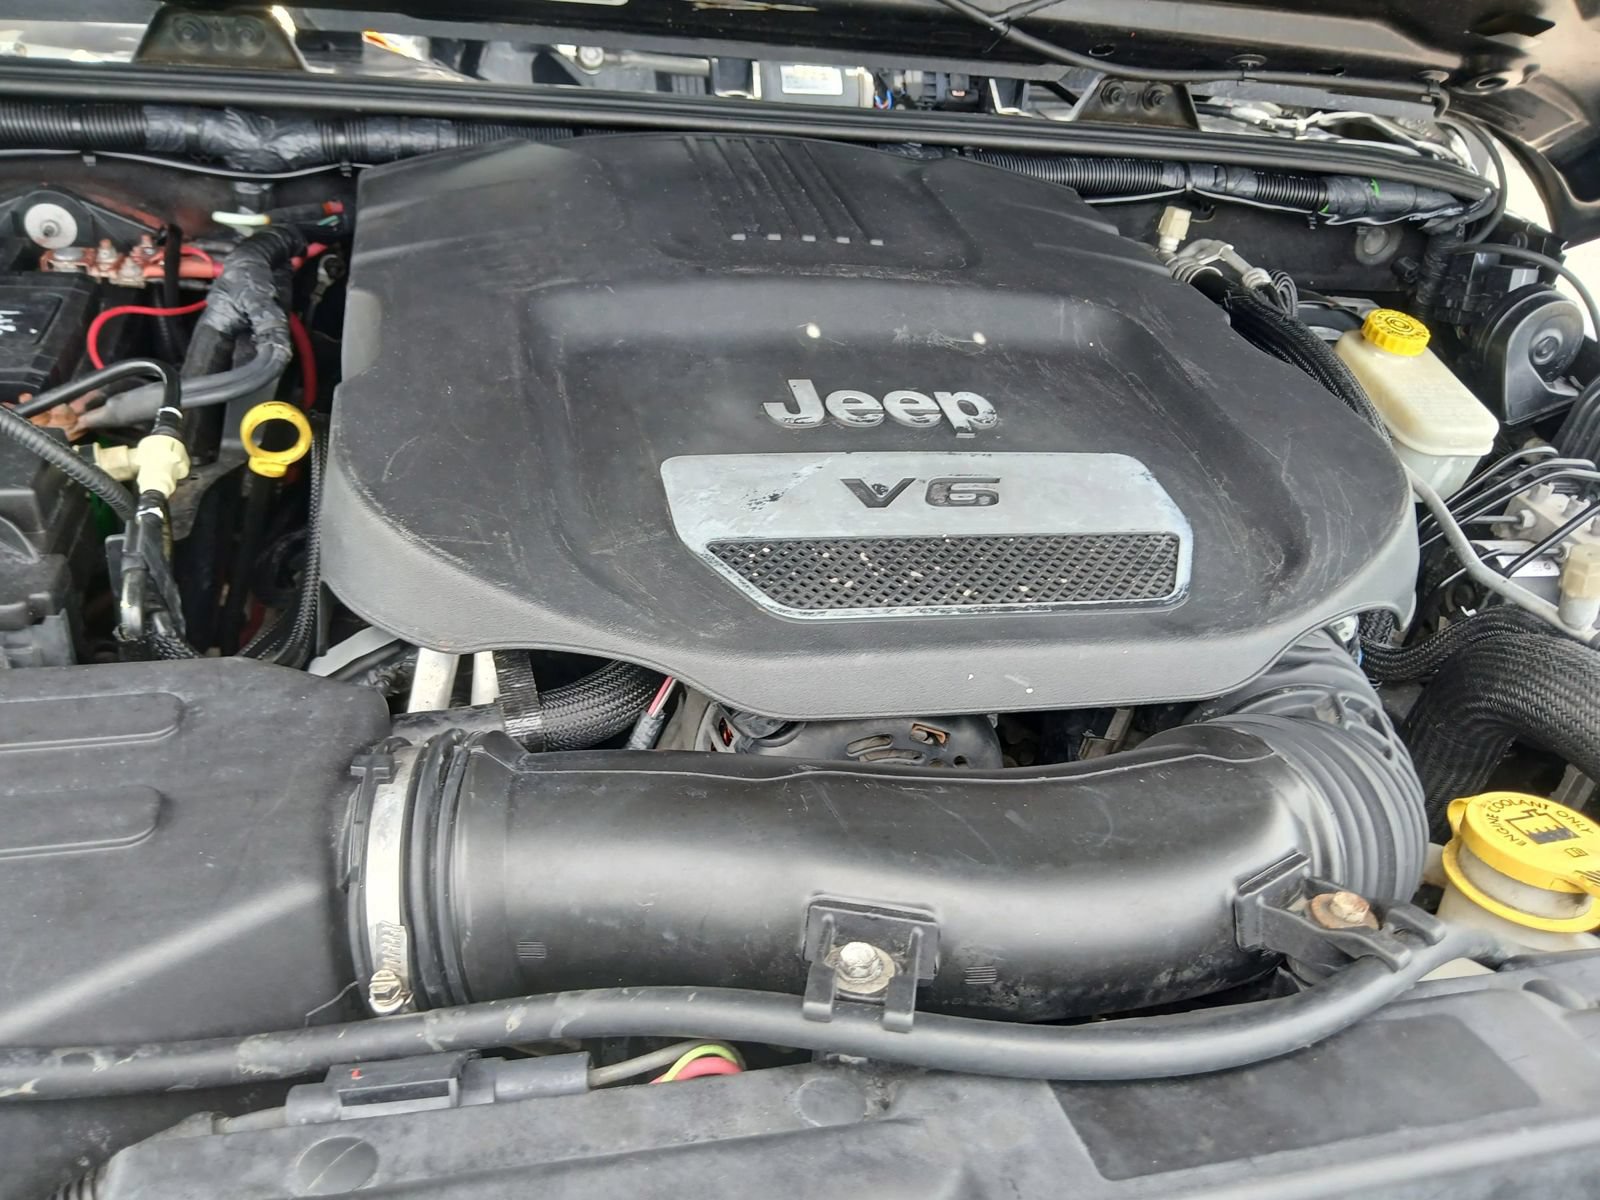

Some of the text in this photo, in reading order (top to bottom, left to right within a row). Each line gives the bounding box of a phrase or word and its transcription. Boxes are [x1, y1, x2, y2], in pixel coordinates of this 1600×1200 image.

[763, 379, 999, 438] Jeep
[840, 477, 1001, 508] V6
[1486, 798, 1594, 846] ENGINE COOLANT ONLY
